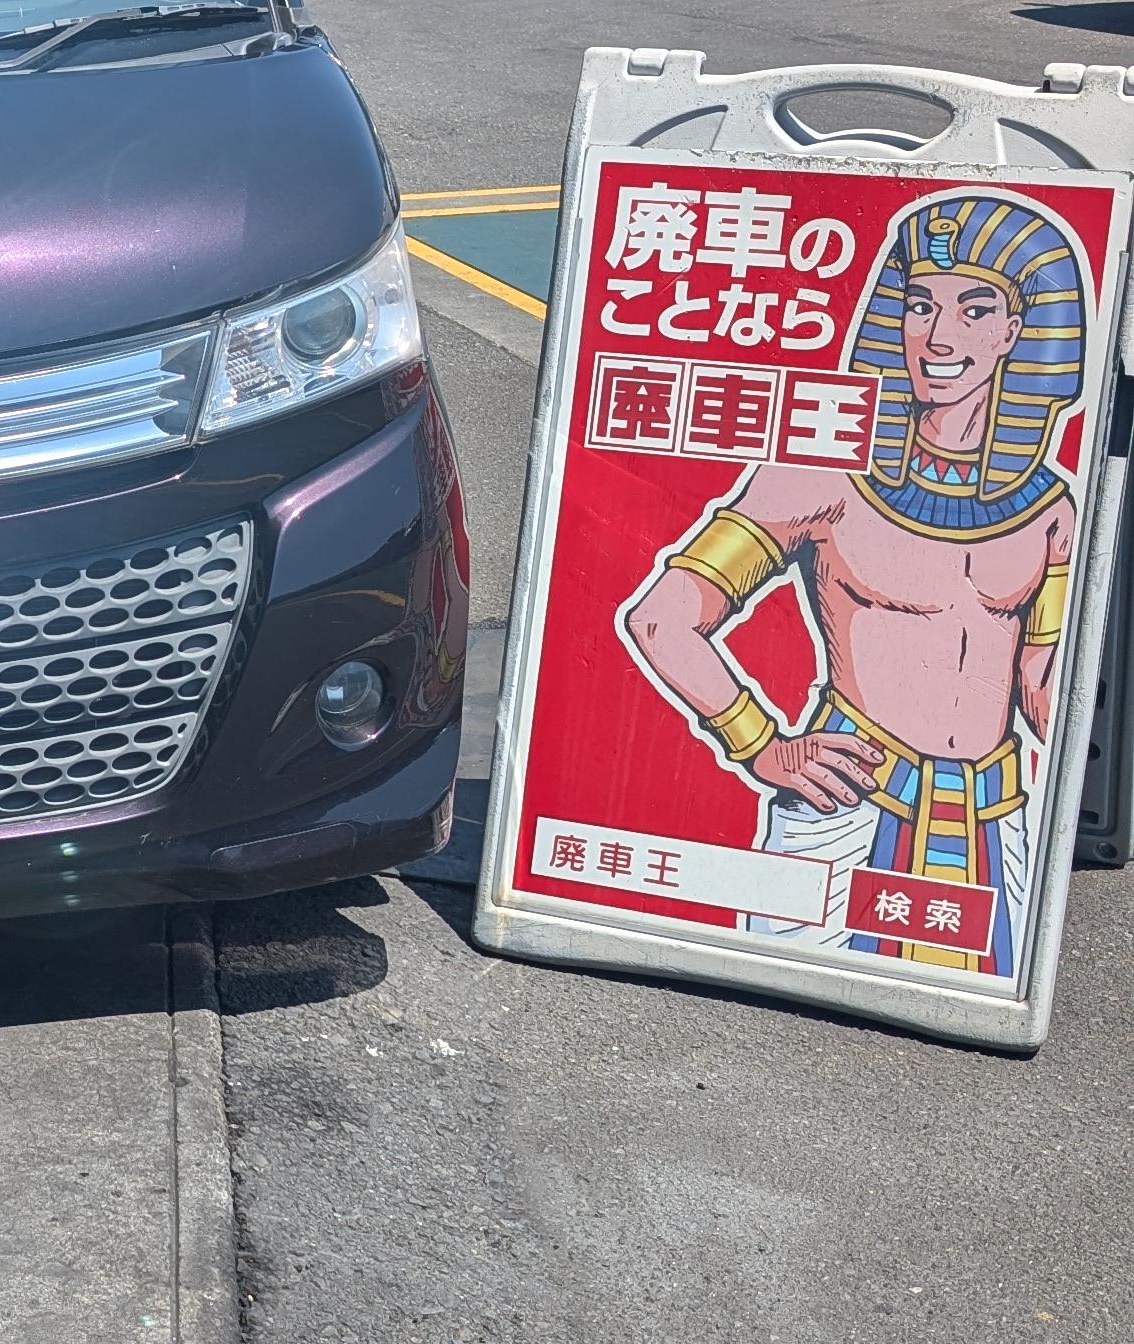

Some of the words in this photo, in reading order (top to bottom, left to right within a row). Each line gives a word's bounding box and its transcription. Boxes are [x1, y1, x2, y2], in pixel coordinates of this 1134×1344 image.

[604, 182, 855, 280] 廃車の
[599, 278, 836, 352] ことなら
[588, 359, 876, 468] 廃車王
[549, 833, 682, 888] 廃車王
[874, 887, 963, 934] 検索
